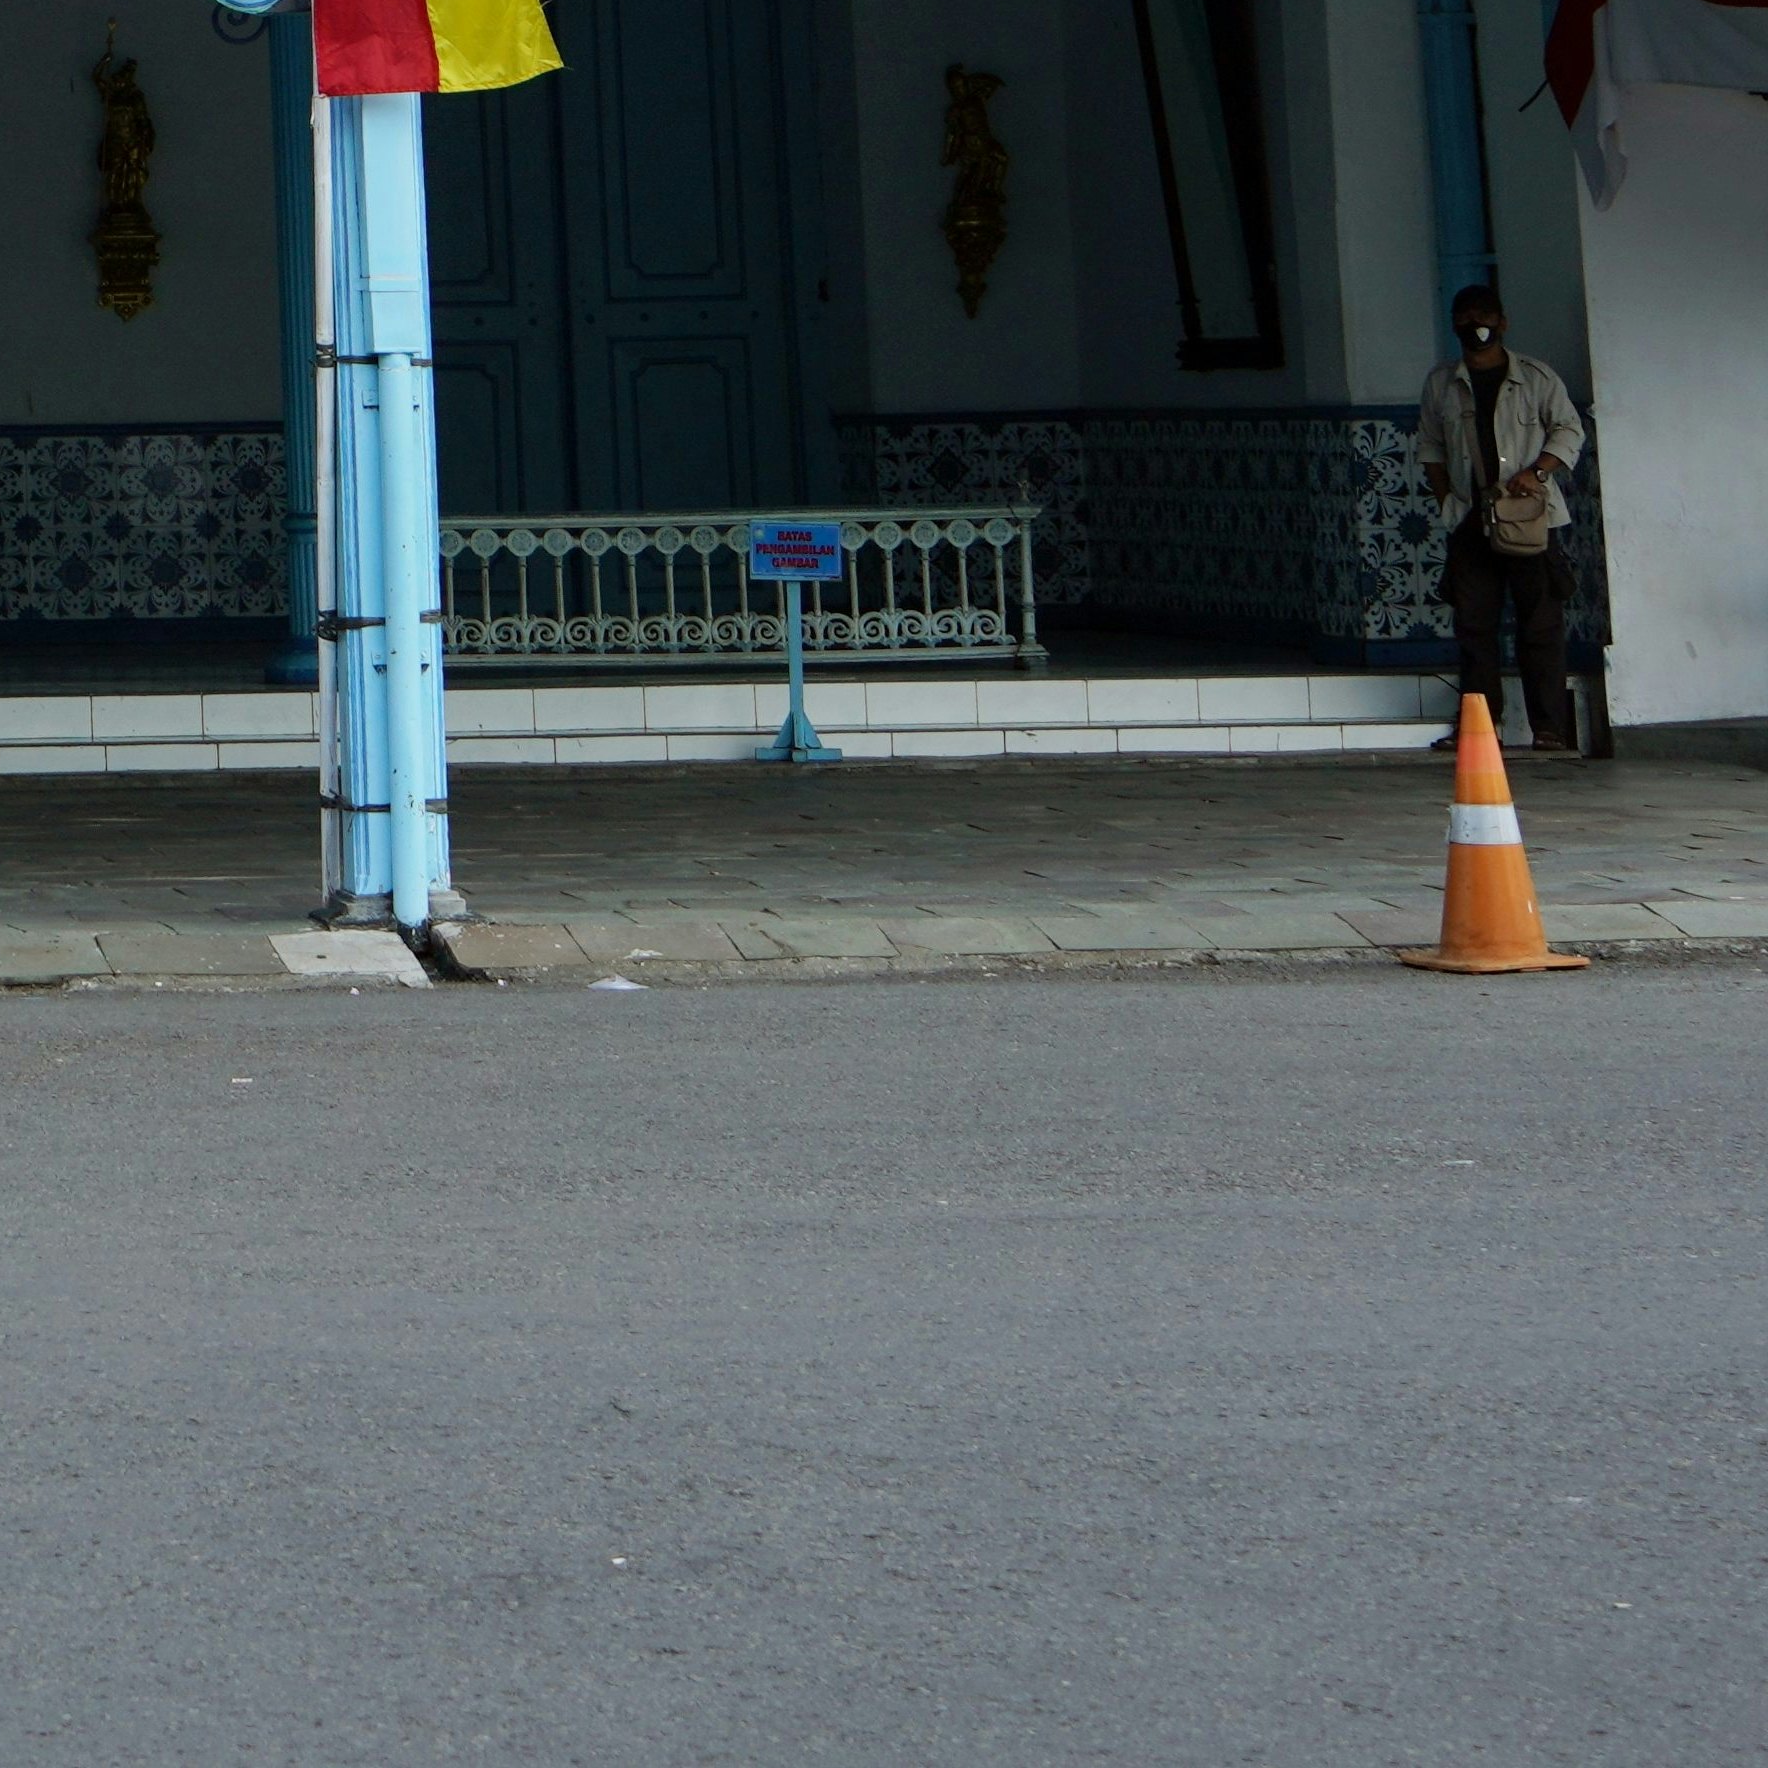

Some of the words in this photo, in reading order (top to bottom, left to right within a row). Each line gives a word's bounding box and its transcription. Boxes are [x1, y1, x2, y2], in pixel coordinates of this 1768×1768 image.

[777, 531, 812, 541] BATAS
[756, 544, 834, 555] PENGAMBILAN
[772, 558, 818, 569] GAMBAR
